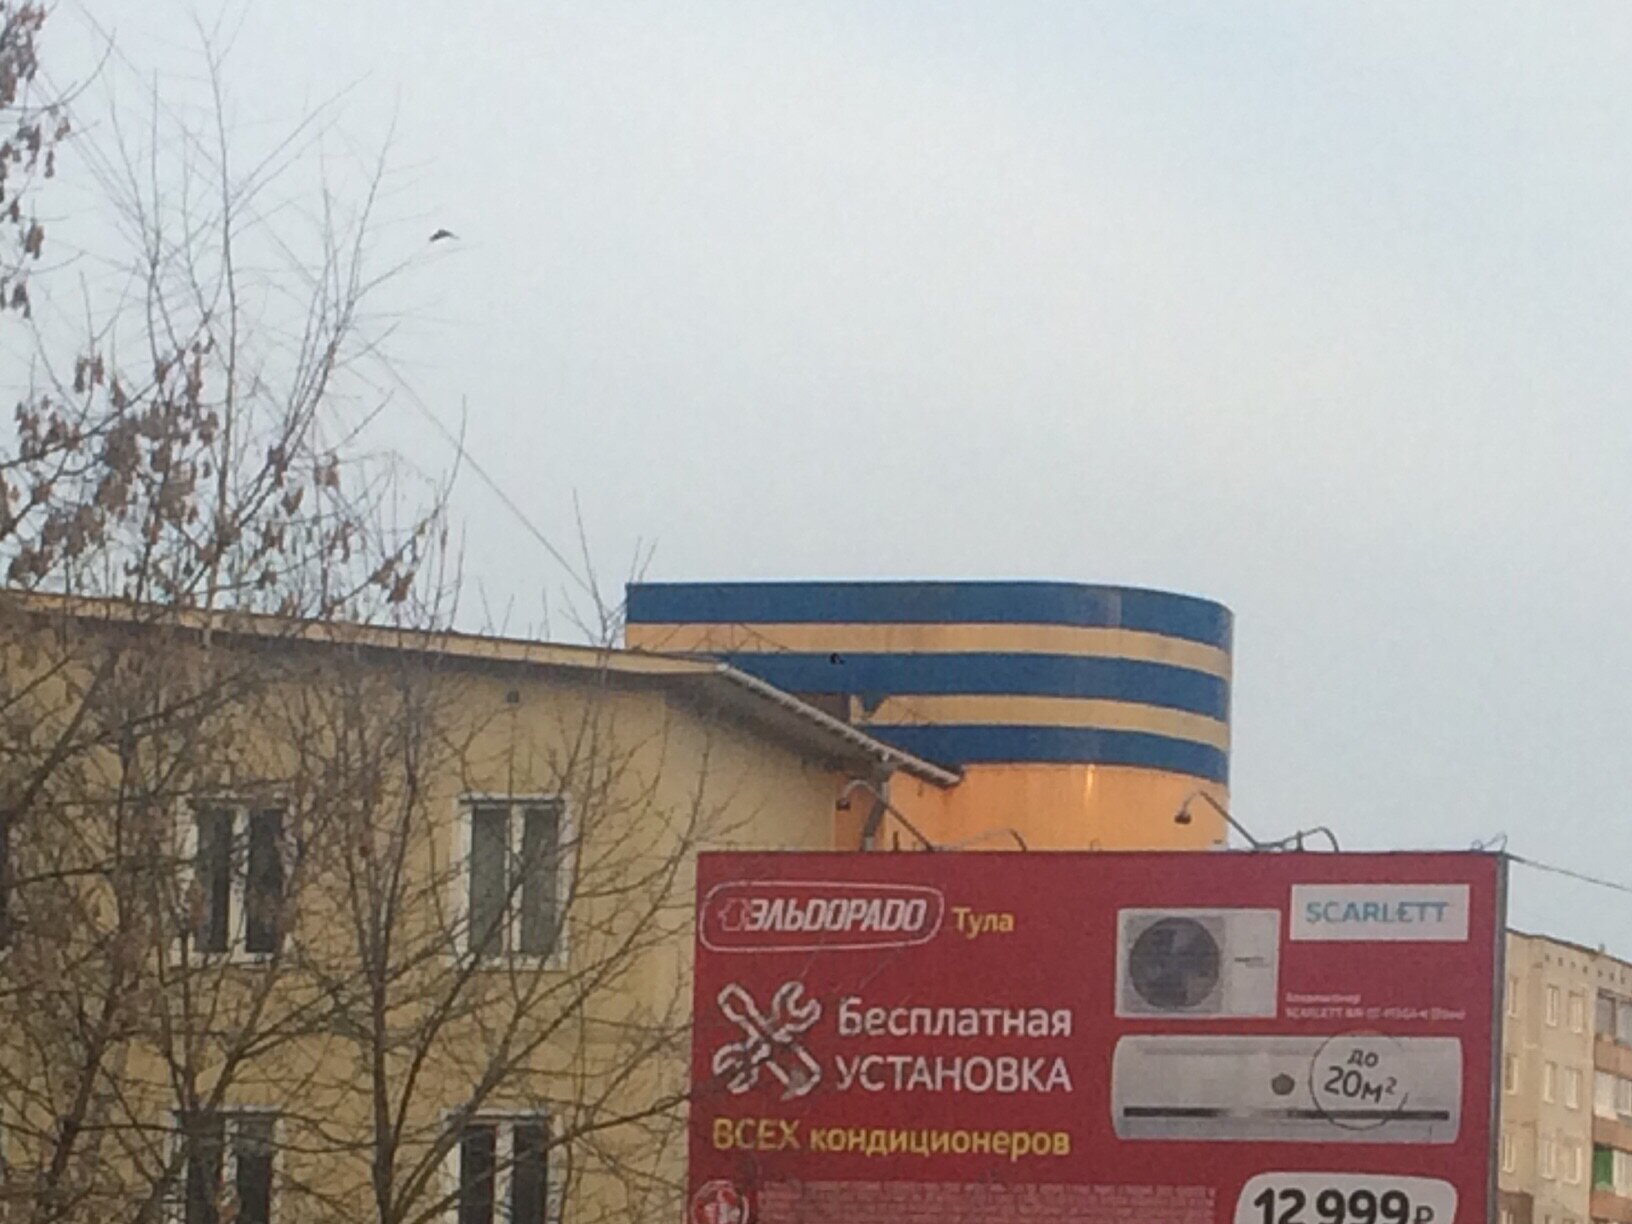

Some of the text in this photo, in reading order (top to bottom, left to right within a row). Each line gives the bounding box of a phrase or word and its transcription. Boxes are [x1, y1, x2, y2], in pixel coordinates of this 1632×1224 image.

[951, 907, 1015, 939] Тула
[1305, 901, 1450, 924] SCARLETT
[837, 997, 1072, 1038] Бесплатная
[835, 1055, 1073, 1093] УСТАНОВКА
[712, 1118, 1071, 1162] ВСЕХ кондиционеров
